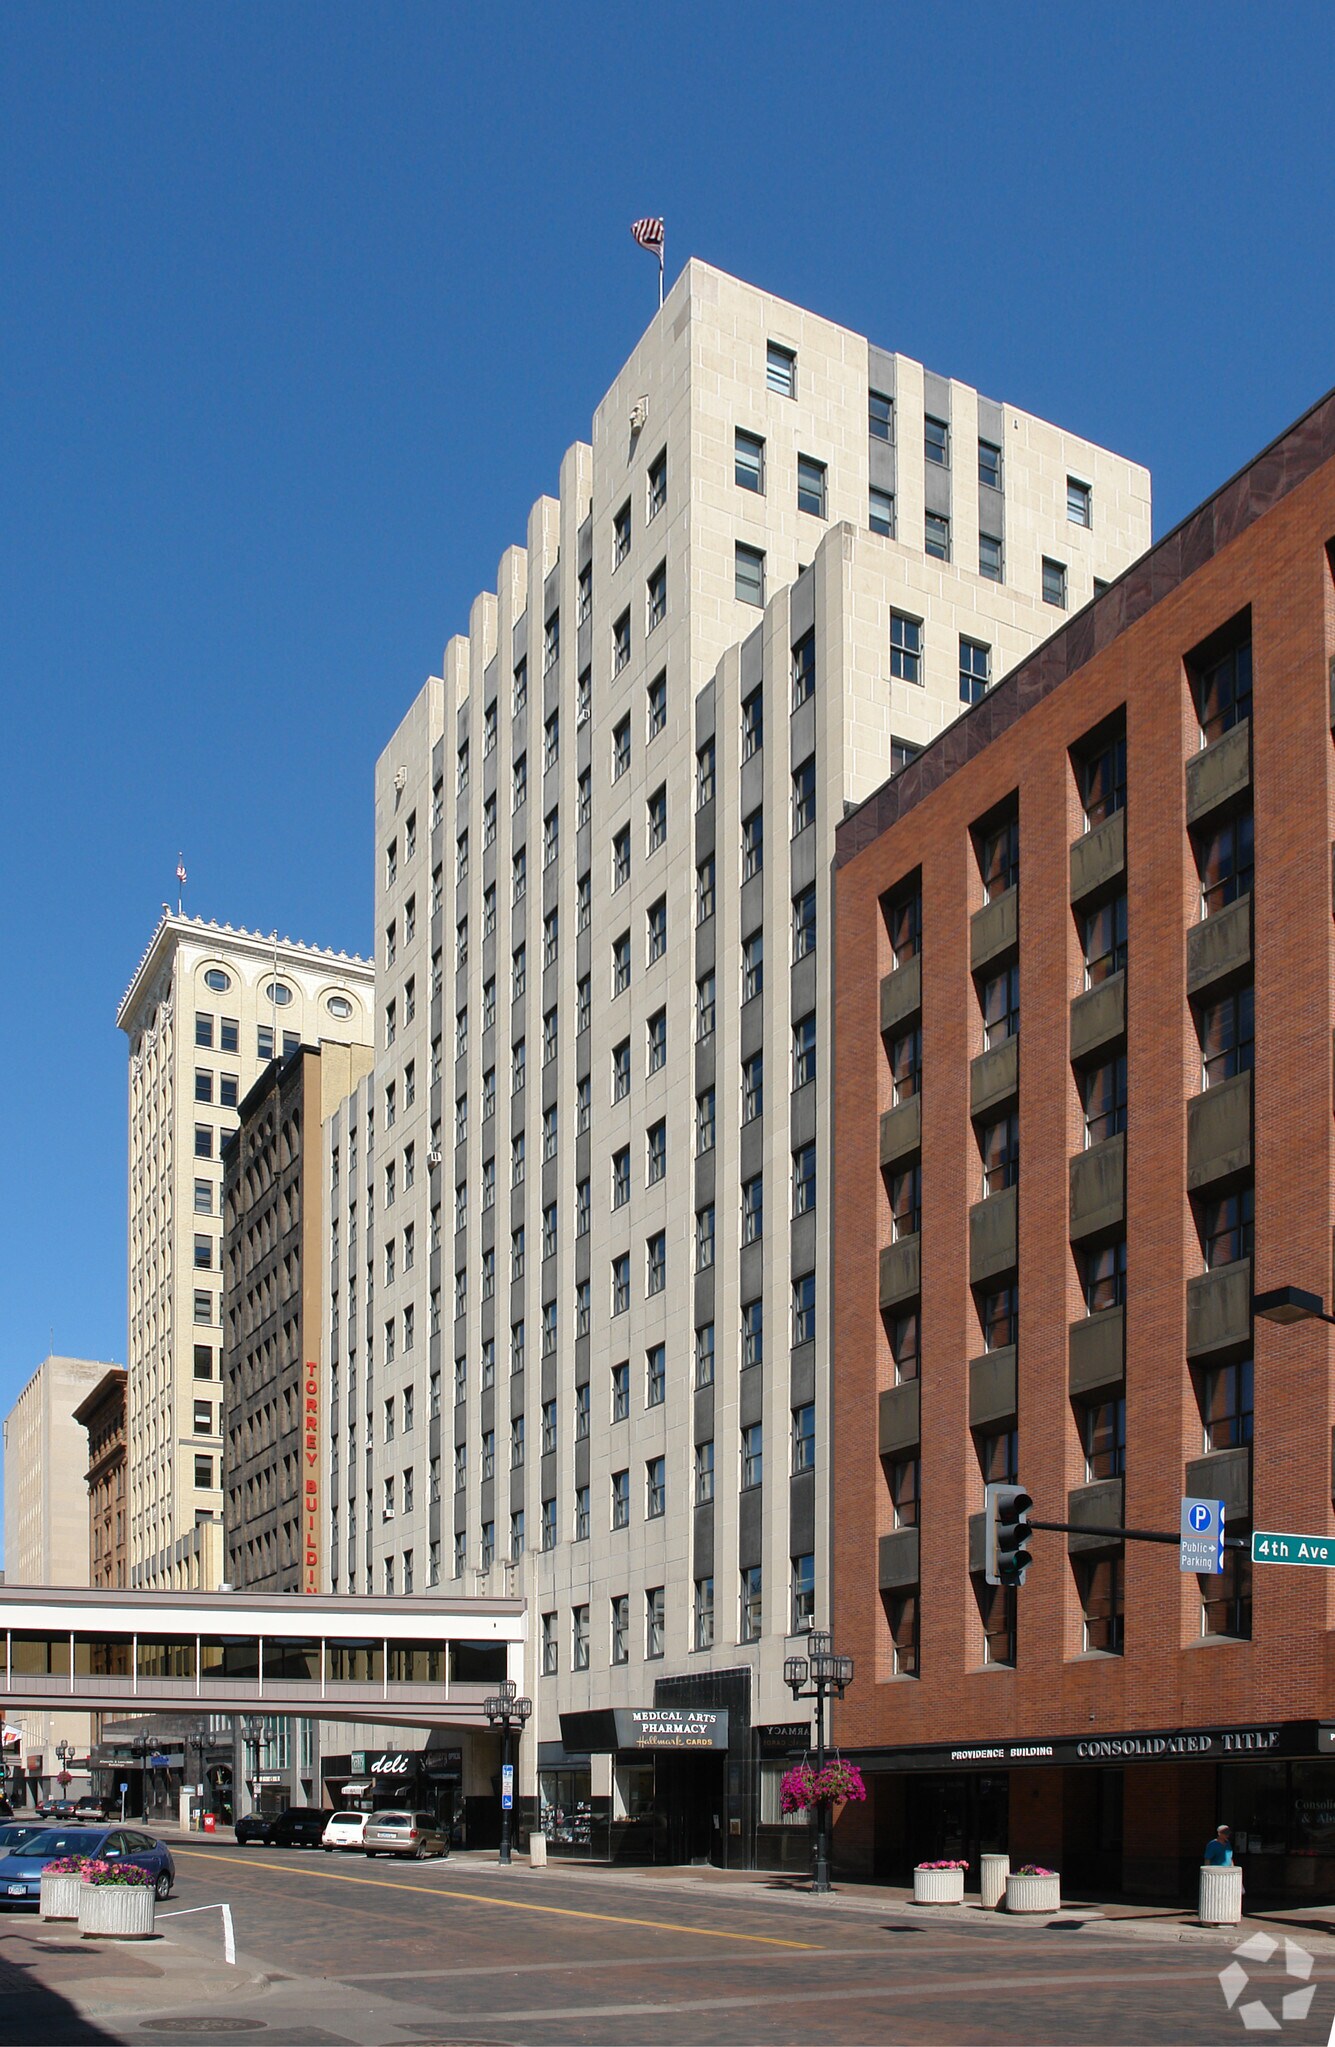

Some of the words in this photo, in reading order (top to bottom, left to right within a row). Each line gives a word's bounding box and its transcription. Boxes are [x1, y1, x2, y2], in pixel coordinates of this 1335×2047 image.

[305, 1361, 318, 1467] TORREY
[1195, 1506, 1206, 1529] P
[1181, 1541, 1208, 1554] Public
[1258, 1540, 1289, 1557] 4th
[1297, 1542, 1329, 1559] Ave
[1181, 1554, 1212, 1571] Parking
[632, 1711, 682, 1721] MEDICAL
[687, 1712, 717, 1723] ARTS
[641, 1723, 708, 1734] PHARMACY
[636, 1735, 685, 1748] Hallmark
[1076, 1734, 1213, 1758] CONSOLIDATED
[1221, 1731, 1280, 1750] TITLE
[951, 1748, 1004, 1760] PROVIDENCE
[1010, 1746, 1053, 1758] BUILDING
[371, 1754, 409, 1774] deli
